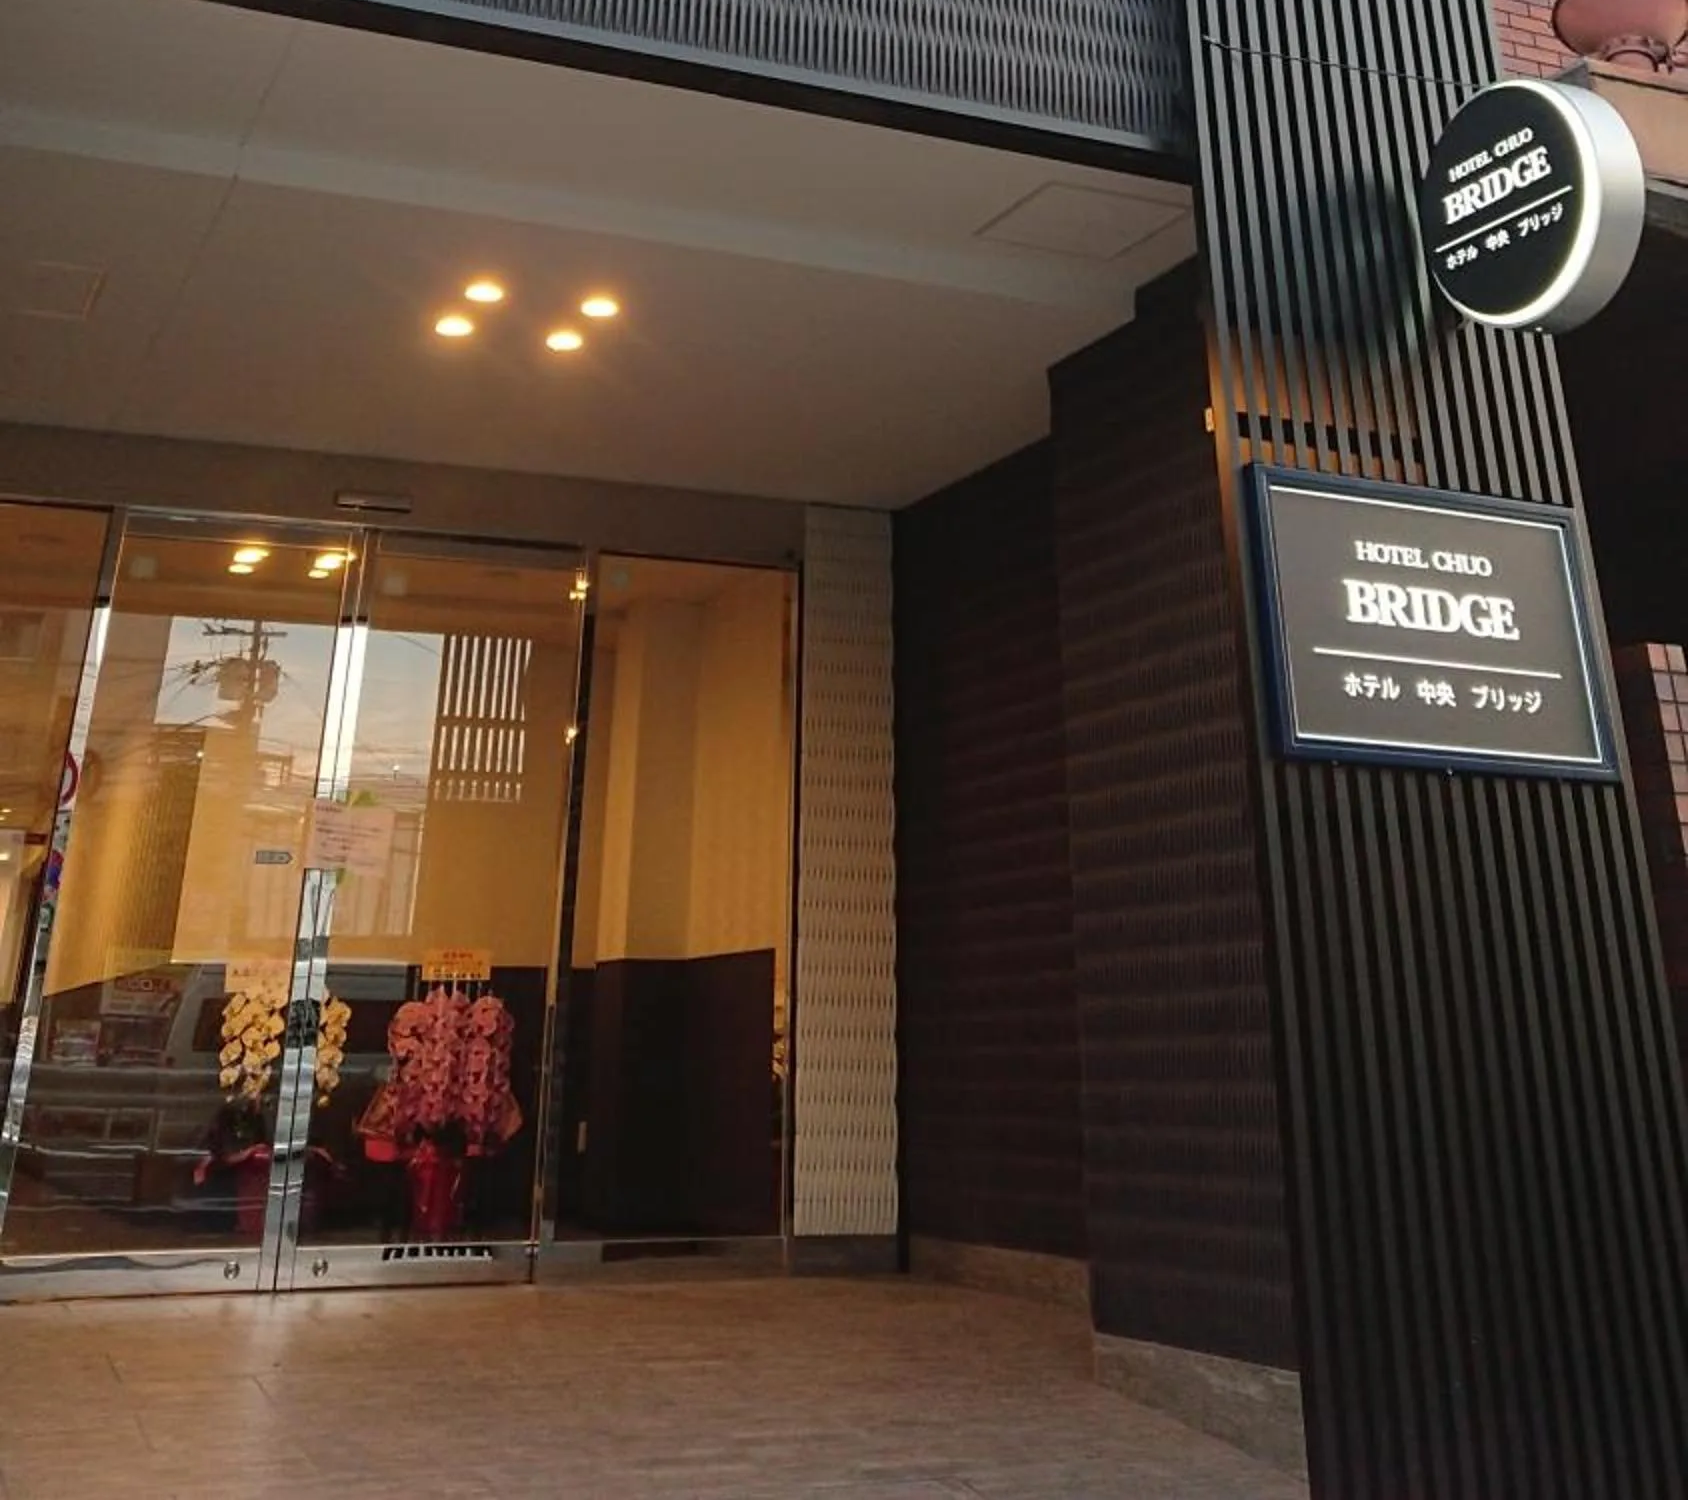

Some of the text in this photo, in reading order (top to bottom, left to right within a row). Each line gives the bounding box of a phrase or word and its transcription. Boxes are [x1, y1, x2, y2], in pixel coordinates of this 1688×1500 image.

[1448, 127, 1534, 182] HOTEL CHUO
[1442, 145, 1552, 225] BRIDGE
[1446, 202, 1563, 270] ホテル 中央 ブリッジ
[1354, 540, 1493, 577] HOTEL CHUO
[1341, 578, 1521, 641] BRIDGE
[1344, 672, 1542, 714] ホテル 中央 ブリッジ
